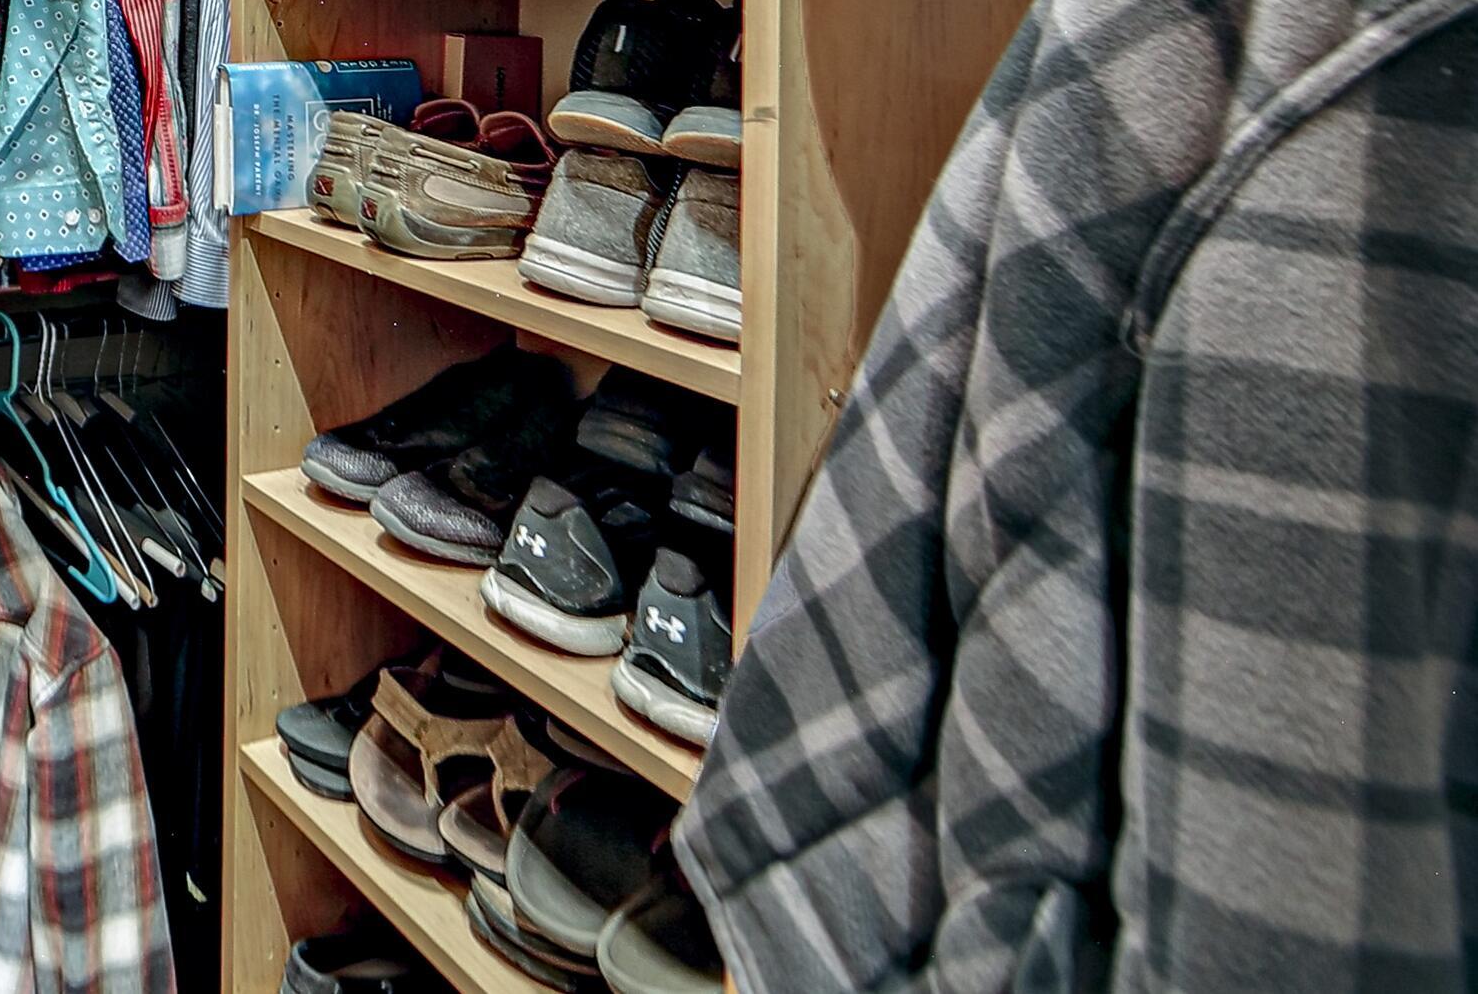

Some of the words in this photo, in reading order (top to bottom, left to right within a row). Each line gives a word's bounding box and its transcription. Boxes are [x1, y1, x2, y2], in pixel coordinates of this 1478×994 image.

[272, 94, 281, 113] THE
[253, 123, 261, 158] JOSEPH
[272, 120, 282, 164] MENTAL
[286, 114, 295, 182] MASTERING
[254, 161, 262, 196] PARENT
